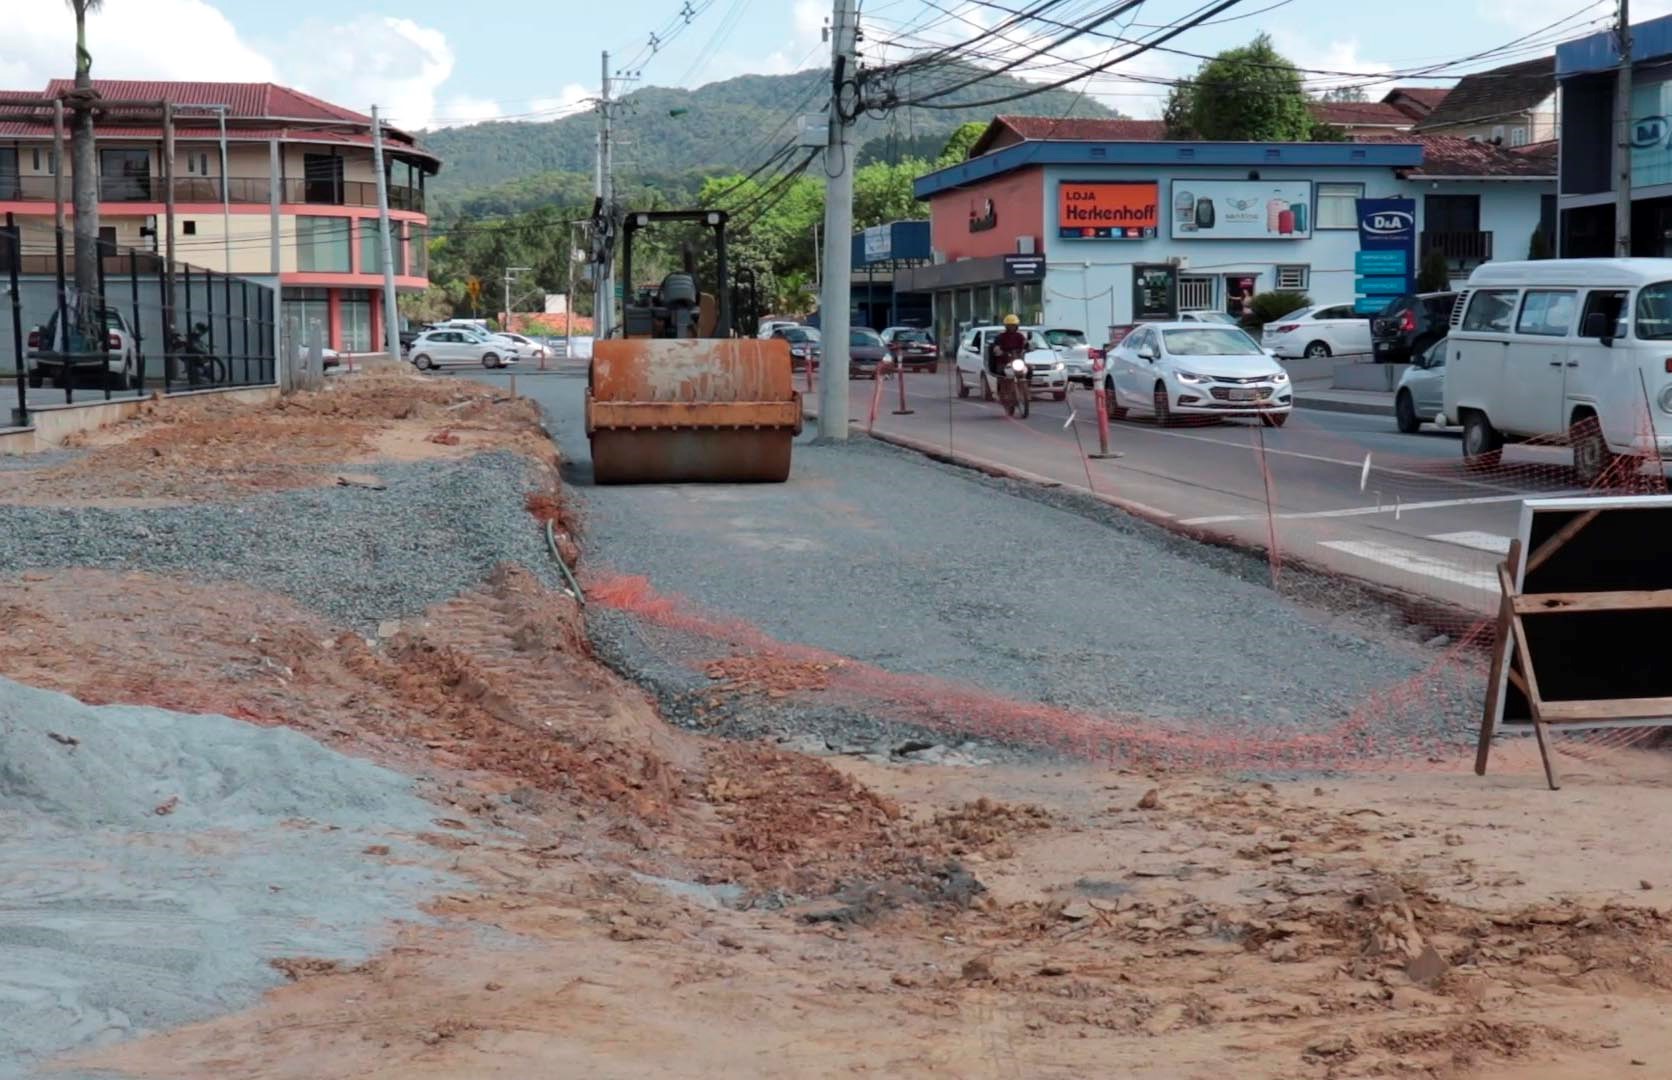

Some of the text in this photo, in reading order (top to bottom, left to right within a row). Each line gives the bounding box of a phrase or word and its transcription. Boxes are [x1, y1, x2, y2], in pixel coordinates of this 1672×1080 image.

[1066, 191, 1096, 200] LOJA
[1066, 204, 1156, 220] Herkenhoff
[1373, 215, 1402, 229] D&A
